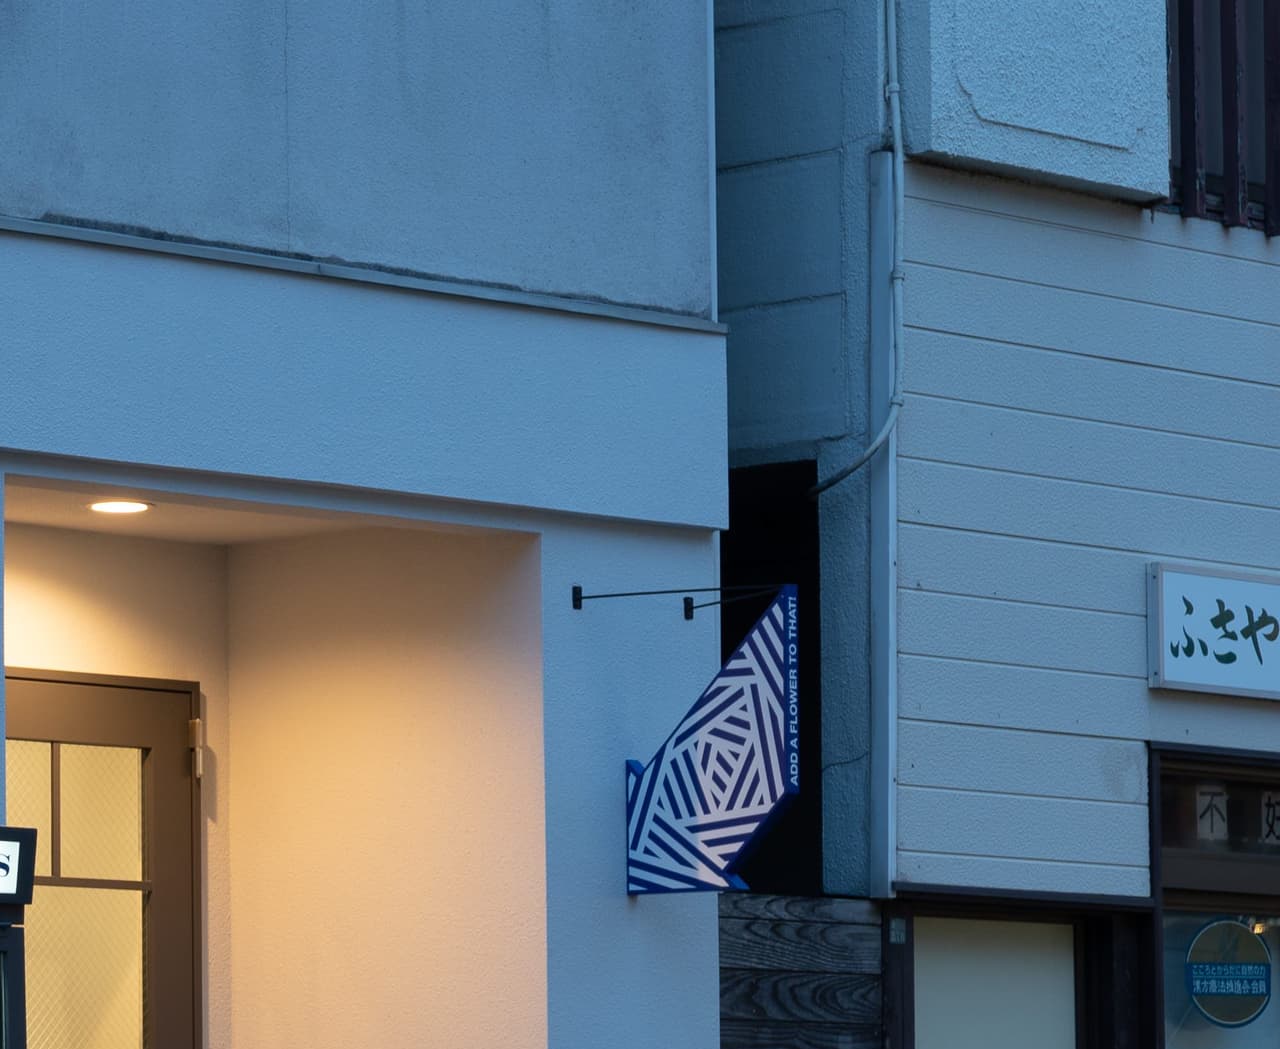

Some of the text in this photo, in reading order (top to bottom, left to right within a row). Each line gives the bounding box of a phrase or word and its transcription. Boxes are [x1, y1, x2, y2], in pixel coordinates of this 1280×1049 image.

[789, 596, 799, 786] ADD A FLOWER TO THAT!
